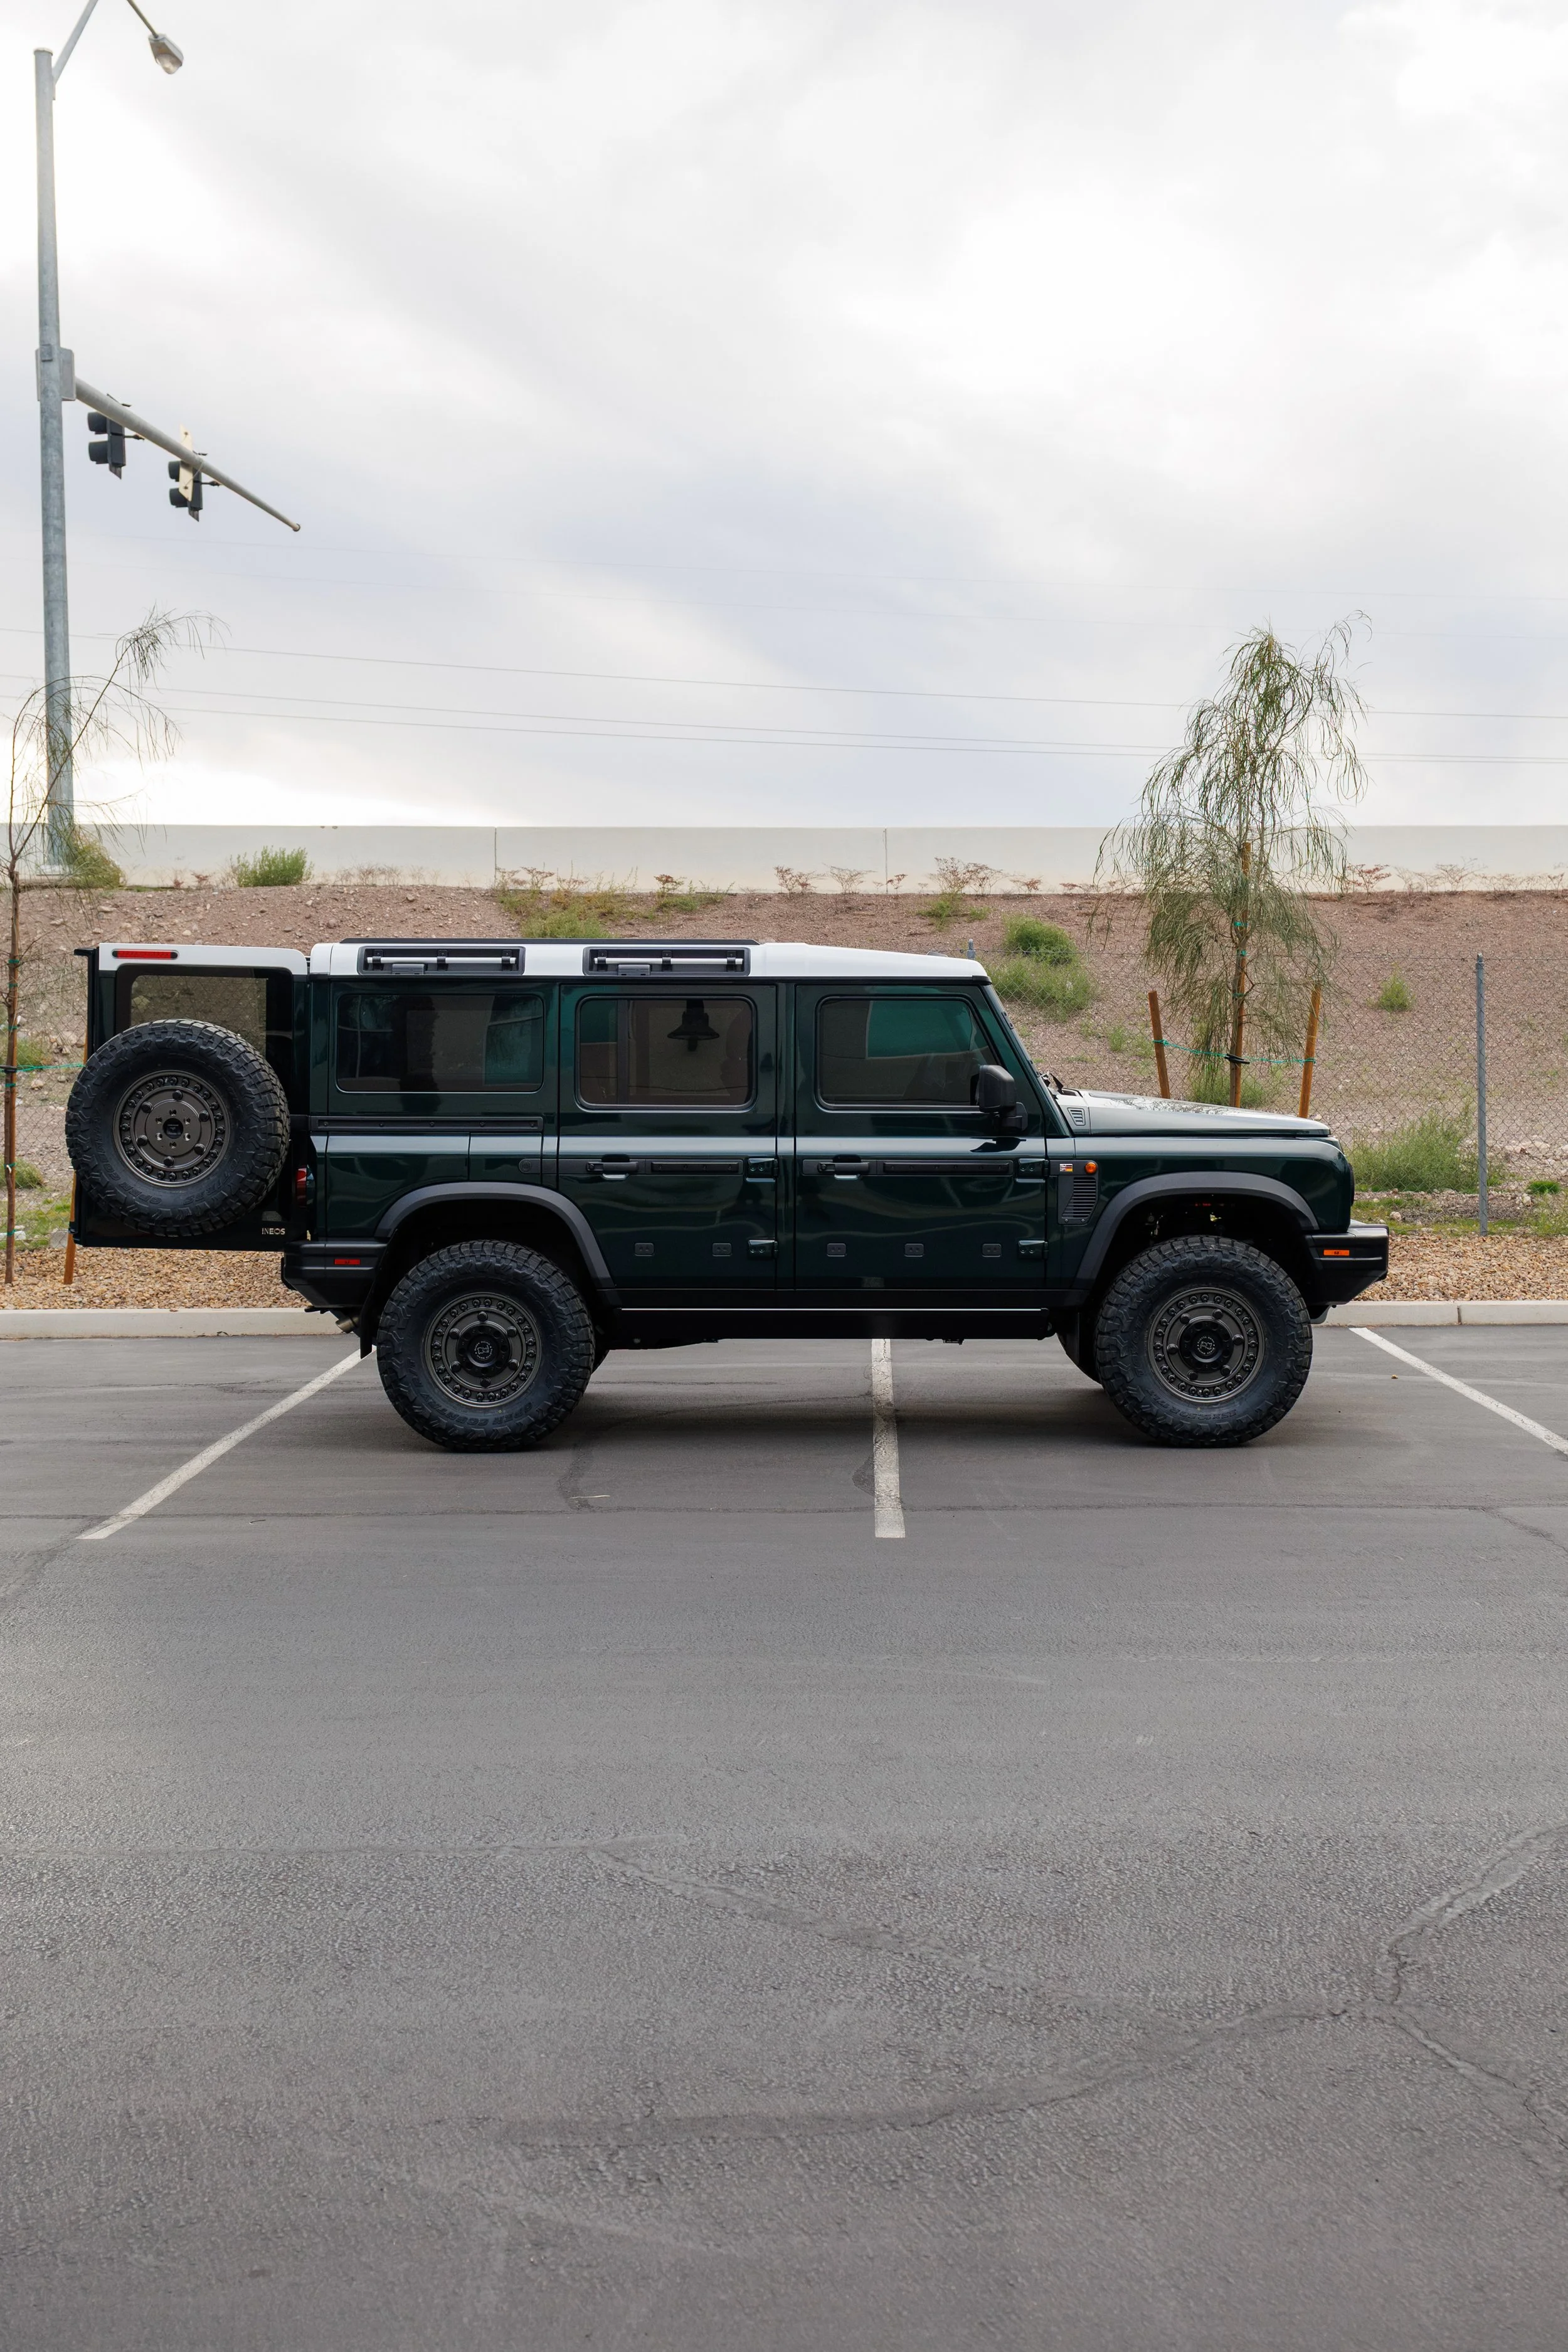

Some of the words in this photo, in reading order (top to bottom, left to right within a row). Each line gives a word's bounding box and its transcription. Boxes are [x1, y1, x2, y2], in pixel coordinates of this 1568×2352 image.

[94, 1108, 122, 1183] COUNTRY
[118, 1179, 162, 1206] OPEN
[420, 1389, 489, 1426] COUNTRY
[492, 1401, 534, 1426] OPEN
